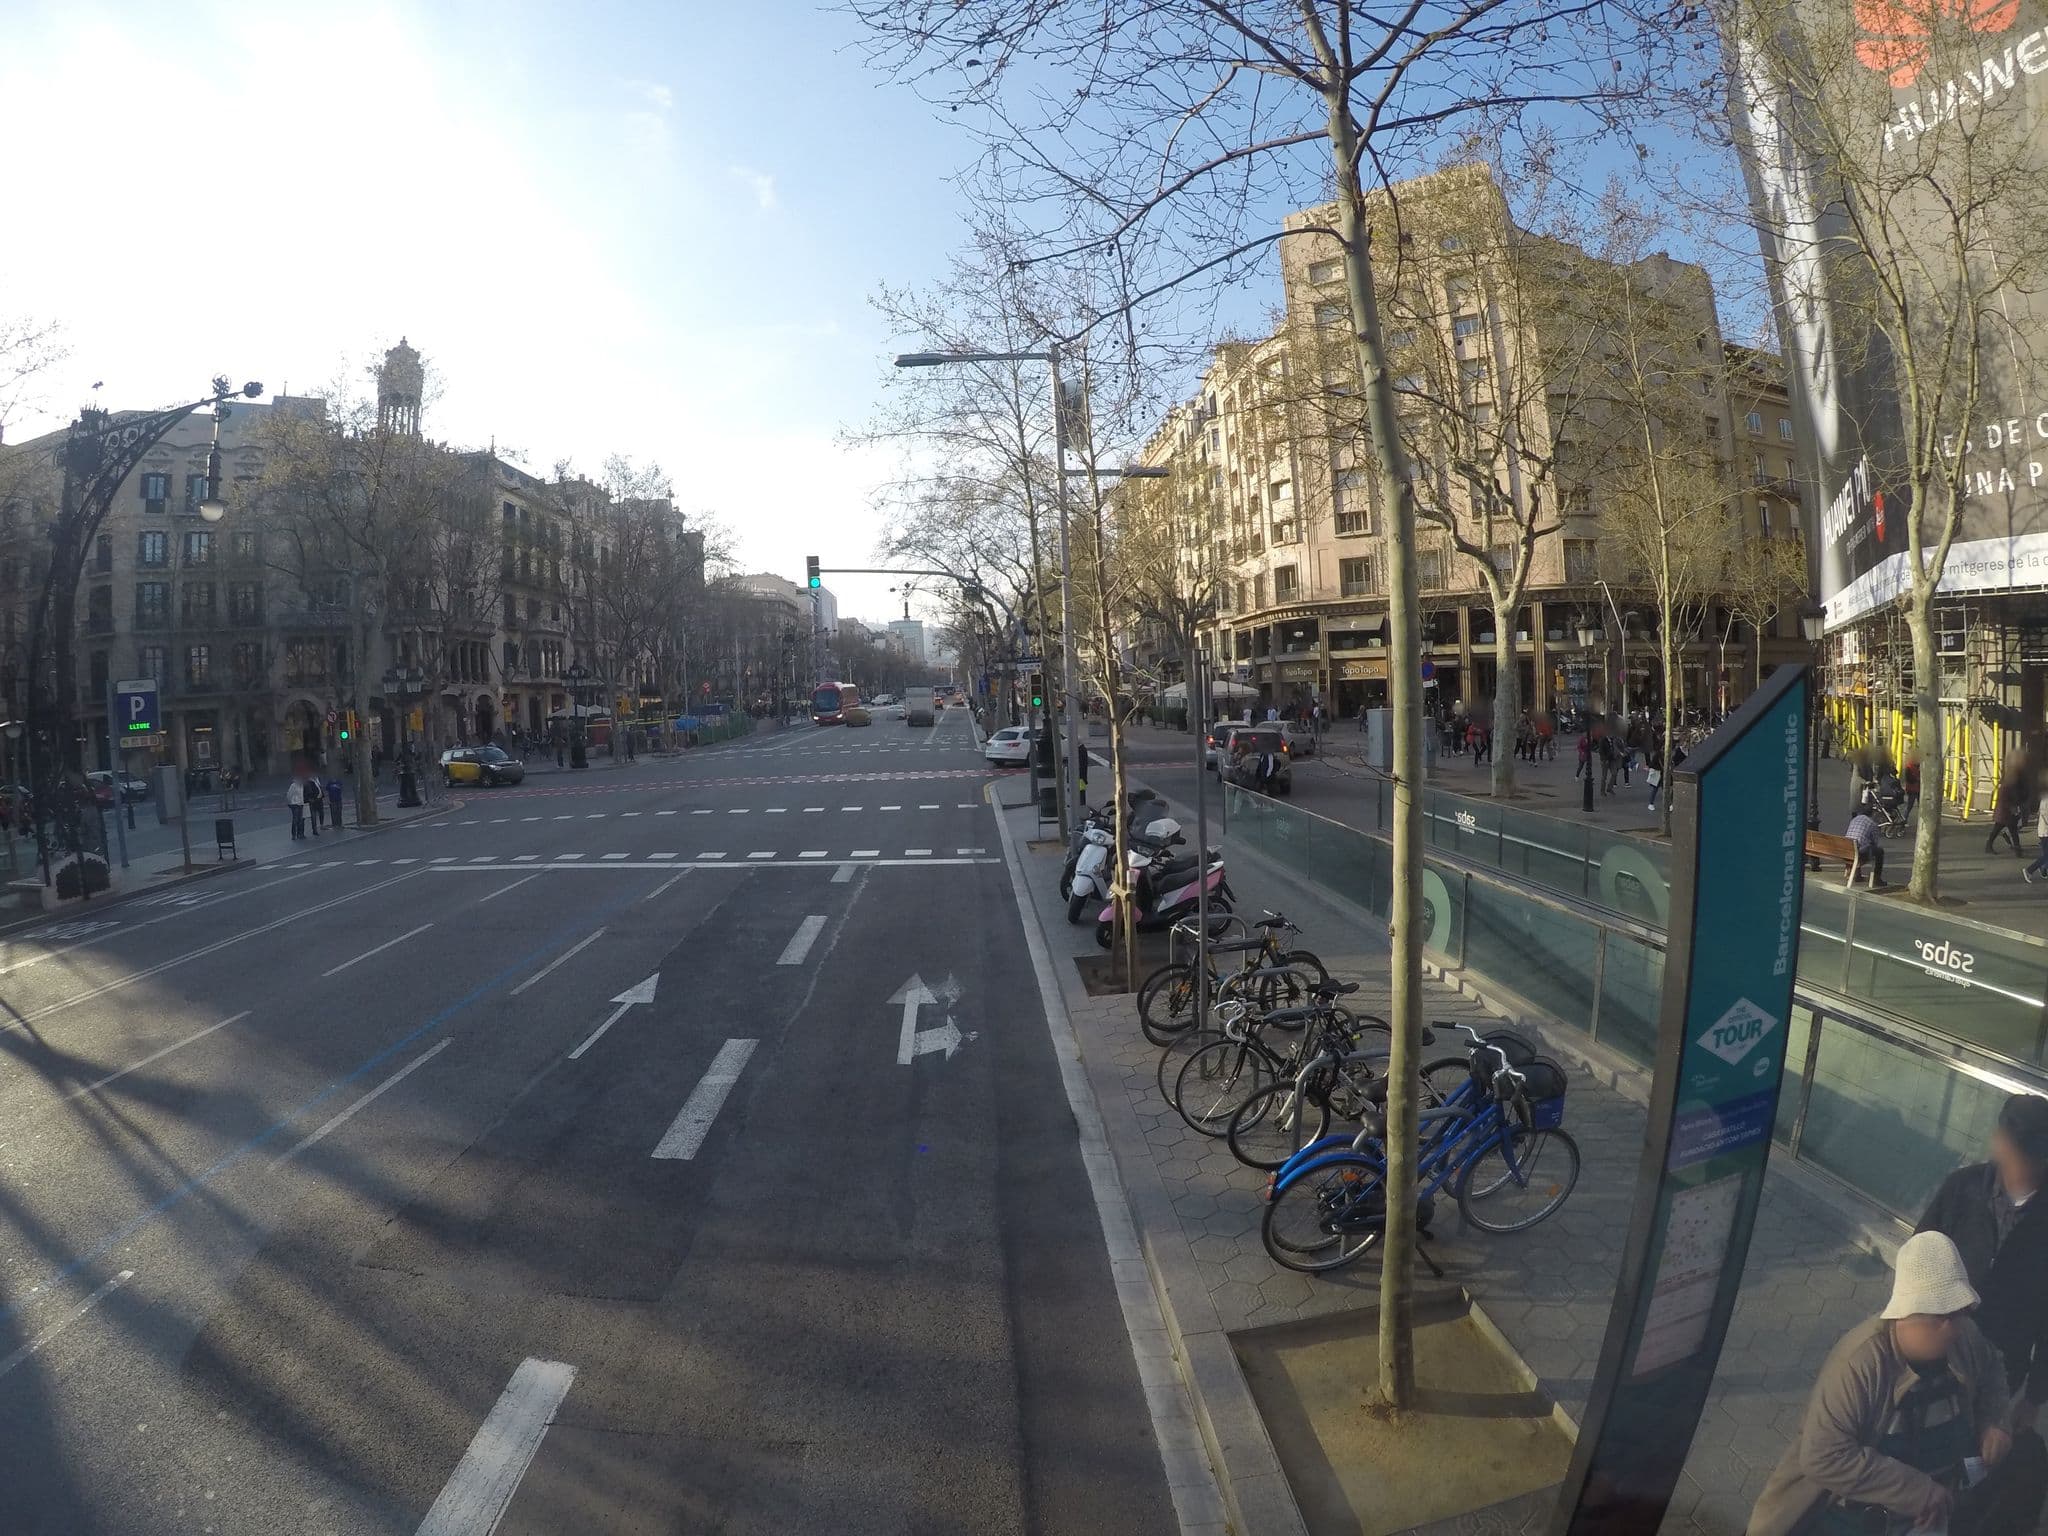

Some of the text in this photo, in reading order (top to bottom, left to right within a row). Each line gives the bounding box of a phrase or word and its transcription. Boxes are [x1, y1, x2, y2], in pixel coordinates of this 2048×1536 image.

[1986, 419, 2022, 449] DE
[1823, 476, 1855, 552] HUAWEI
[1853, 453, 1871, 514] P10
[1949, 559, 2004, 577] mitgeres
[2008, 555, 2024, 570] de
[2027, 553, 2040, 568] la
[130, 696, 145, 721] P
[1773, 850, 1795, 977] Barcelona
[1713, 1018, 1763, 1049] TOUR
